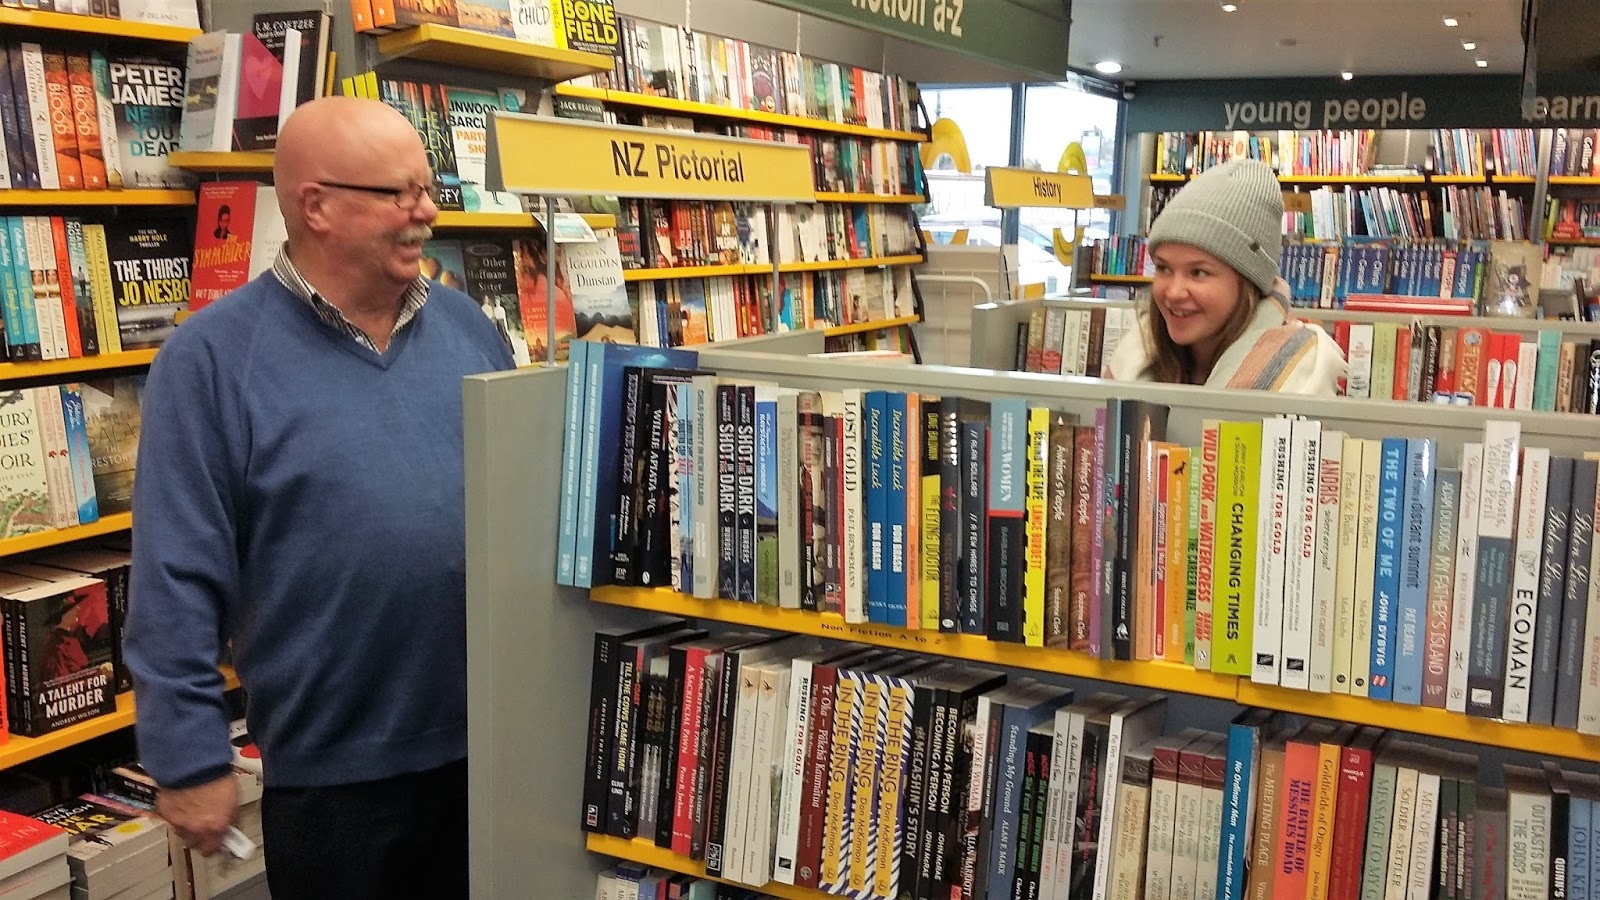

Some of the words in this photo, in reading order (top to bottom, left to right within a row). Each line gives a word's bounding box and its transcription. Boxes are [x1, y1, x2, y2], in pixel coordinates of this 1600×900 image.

[564, 0, 616, 25] BONE
[566, 19, 618, 45] FIELD
[109, 62, 183, 87] PETER
[48, 83, 67, 135] BLOOD
[72, 84, 91, 136] BLOOD
[111, 84, 184, 108] JAMES
[1225, 100, 1312, 129] young
[1324, 92, 1427, 128] people
[1522, 92, 1600, 120] earn
[133, 122, 174, 140] YOU
[610, 139, 649, 178] NZ
[654, 143, 744, 183] Pictorial
[1032, 176, 1062, 204] History
[150, 234, 168, 242] HOLE
[113, 260, 142, 282] THE
[142, 257, 189, 280] THIRST
[483, 258, 506, 268] Other
[119, 283, 142, 306] JO
[143, 278, 191, 303] NESBO
[576, 275, 616, 287] Dunstan
[650, 409, 663, 449] WILLIE
[845, 401, 857, 444] LOST
[871, 408, 881, 461] Incredible
[892, 409, 902, 463] Incredible
[719, 424, 734, 466] SHOT
[738, 425, 753, 467] SHOT
[1203, 429, 1217, 463] WILD
[648, 450, 659, 492] APIATA
[845, 446, 857, 492] GOLD
[871, 464, 882, 489] Luck
[892, 466, 903, 491] Luck
[970, 462, 978, 497] BOLLARD
[1001, 453, 1013, 502] WOMEN
[1275, 437, 1286, 492] RUSHING
[1306, 439, 1317, 494] RUSHING
[1320, 458, 1340, 505] ANDRIS
[1385, 448, 1399, 481] THE
[1486, 444, 1502, 487] Yellow
[719, 475, 734, 513] DARK
[738, 477, 753, 516] DARK
[1032, 481, 1043, 500] TAPE
[1201, 464, 1216, 502] PORK
[1032, 505, 1043, 531] LANCE
[1053, 489, 1065, 520] People
[1077, 493, 1090, 525] People
[1274, 494, 1284, 516] FOR
[1304, 497, 1314, 520] FOR
[1383, 487, 1397, 521] TWO
[926, 507, 940, 542] FLYING
[1273, 519, 1282, 555] GOLD
[1382, 527, 1395, 547] OF
[1409, 503, 1425, 543] distant
[1546, 507, 1567, 555] Stolen
[1571, 508, 1593, 557] Stolen
[1000, 526, 1009, 566] BARBARA
[1228, 502, 1244, 590] CHANGING
[1303, 523, 1312, 558] GOLD
[925, 543, 940, 581] DOCTOR
[1198, 522, 1213, 603] WATERCRESS
[1380, 554, 1394, 578] ME
[1406, 546, 1422, 589] summit
[1435, 555, 1452, 574] MY
[999, 568, 1008, 607] BROOKES
[1431, 575, 1450, 629] FATHER'S
[1226, 592, 1241, 640] TIMES
[1378, 591, 1389, 622] JOHN
[821, 623, 843, 633] Non
[850, 627, 892, 639] Fiction
[915, 635, 927, 644] to
[1376, 624, 1389, 666] DYBVIG
[1509, 588, 1534, 690] ECOMAN
[624, 662, 632, 678] TILL
[1428, 632, 1446, 675] ISLAND
[39, 692, 46, 705] A
[47, 680, 85, 702] TALENT
[87, 674, 107, 691] FOR
[46, 689, 104, 718] MURDER
[683, 672, 695, 726] SACRIFICIAL
[799, 677, 809, 723] RUSHING
[820, 697, 832, 716] Oka
[822, 684, 832, 695] Te
[841, 687, 852, 706] IN
[866, 690, 878, 710] IN
[891, 694, 903, 713] IN
[51, 715, 76, 729] ANDREW
[77, 708, 100, 722] WILSON
[620, 695, 630, 720] COWS
[619, 722, 628, 745] CAME
[796, 725, 804, 749] FOR
[836, 711, 850, 742] THE
[862, 715, 875, 746] THE
[887, 718, 900, 750] THE
[932, 706, 945, 760] BECOMING
[945, 707, 958, 762] BECOMING
[617, 747, 626, 772] HOME
[1006, 725, 1019, 763] Standing
[794, 751, 803, 776] GOLD
[832, 744, 847, 782] RING
[859, 749, 872, 788] RING
[884, 753, 897, 793] RING
[1004, 765, 1016, 779] My
[1234, 760, 1243, 773] No
[833, 792, 842, 810] Don
[927, 770, 939, 811] PERSON
[939, 772, 951, 814] PERSON
[969, 770, 981, 810] WOMAN
[1003, 781, 1013, 813] Ground
[1230, 774, 1241, 807] Ordinary
[1300, 781, 1311, 804] THE
[1318, 759, 1333, 810] Goldfields
[858, 797, 867, 816] Don
[884, 802, 892, 821] Don
[1230, 808, 1238, 827] Man
[1261, 778, 1273, 829] MEETING
[1286, 778, 1299, 838] MESSINES
[1318, 813, 1329, 823] of
[1372, 778, 1389, 839] MESSAGE
[1399, 787, 1412, 831] SOLDIER
[1421, 790, 1433, 820] MEN
[829, 812, 841, 857] McKinnon
[855, 818, 866, 863] McKinnon
[879, 823, 892, 869] McKinnon
[905, 817, 918, 858] STORY
[936, 832, 945, 855] JOHN
[1296, 809, 1309, 853] BATTLE
[1314, 826, 1327, 858] Otago
[1514, 819, 1527, 839] THE
[1531, 805, 1545, 860] OUTCASTS
[922, 852, 931, 878] McRAE
[1258, 833, 1270, 866] PLACE
[1283, 841, 1295, 875] ROAD
[1295, 857, 1306, 874] OF
[1392, 844, 1406, 887] SETTLER
[1414, 841, 1429, 888] VALOUR
[934, 855, 943, 881] McRAE
[963, 859, 976, 896] MARRIOTT
